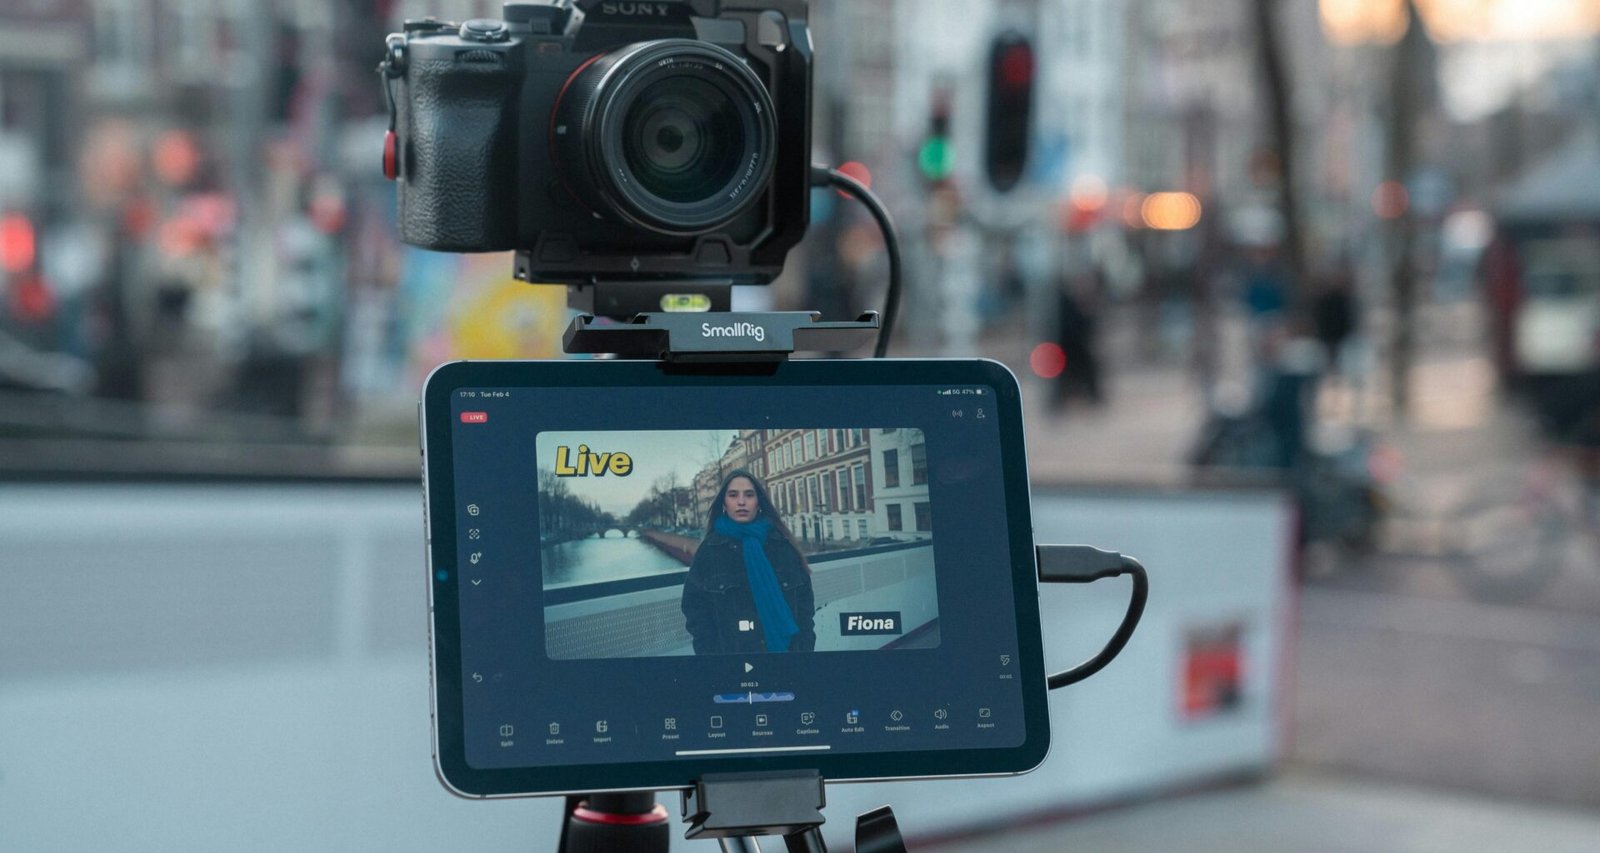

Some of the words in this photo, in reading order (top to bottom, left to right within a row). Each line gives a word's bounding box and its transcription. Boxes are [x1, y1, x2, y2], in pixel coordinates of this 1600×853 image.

[602, 2, 669, 16] SONY
[702, 322, 765, 342] SmallRig
[555, 444, 633, 477] Live
[847, 615, 894, 630] Fiona
